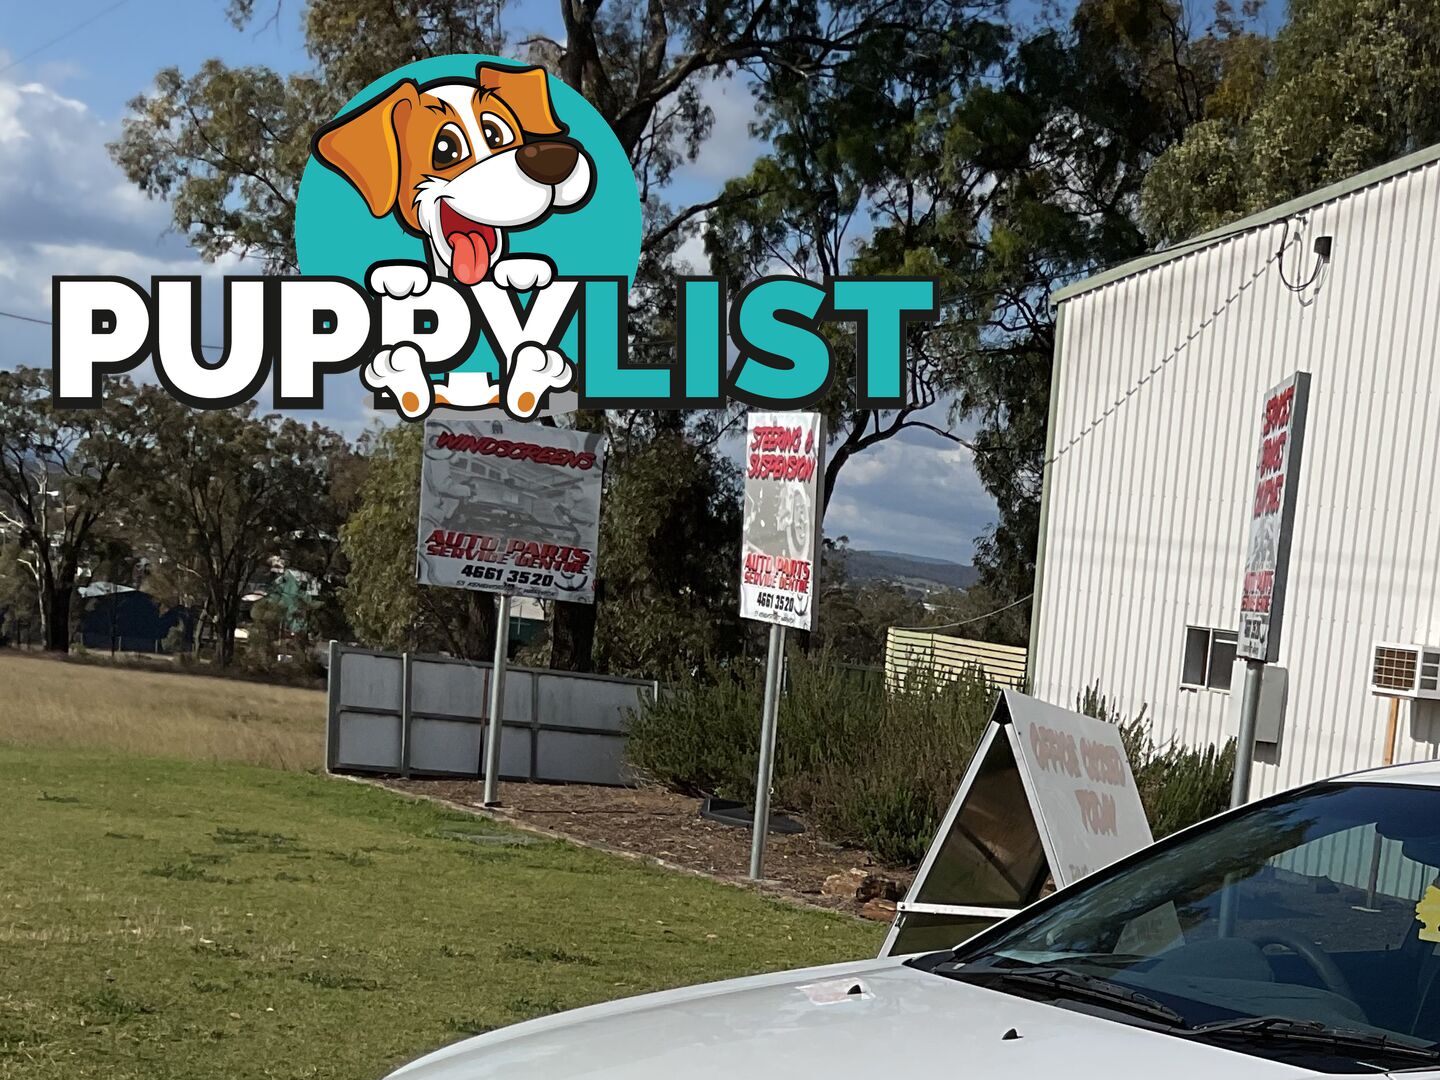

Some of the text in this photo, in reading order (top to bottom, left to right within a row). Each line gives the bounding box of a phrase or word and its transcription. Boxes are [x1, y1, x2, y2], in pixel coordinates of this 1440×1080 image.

[436, 431, 597, 471] WINDSCREENS
[750, 425, 802, 453] STEERING
[747, 454, 816, 484] SUSPENSION
[425, 529, 591, 565] AUTO PARTS
[426, 544, 590, 575] SERVICE CENTRE
[461, 564, 554, 587] 4661 3520
[744, 553, 811, 581] AUTO PARTS
[744, 571, 810, 594] SERVICE CENTRE
[757, 592, 795, 612] 4661 3520
